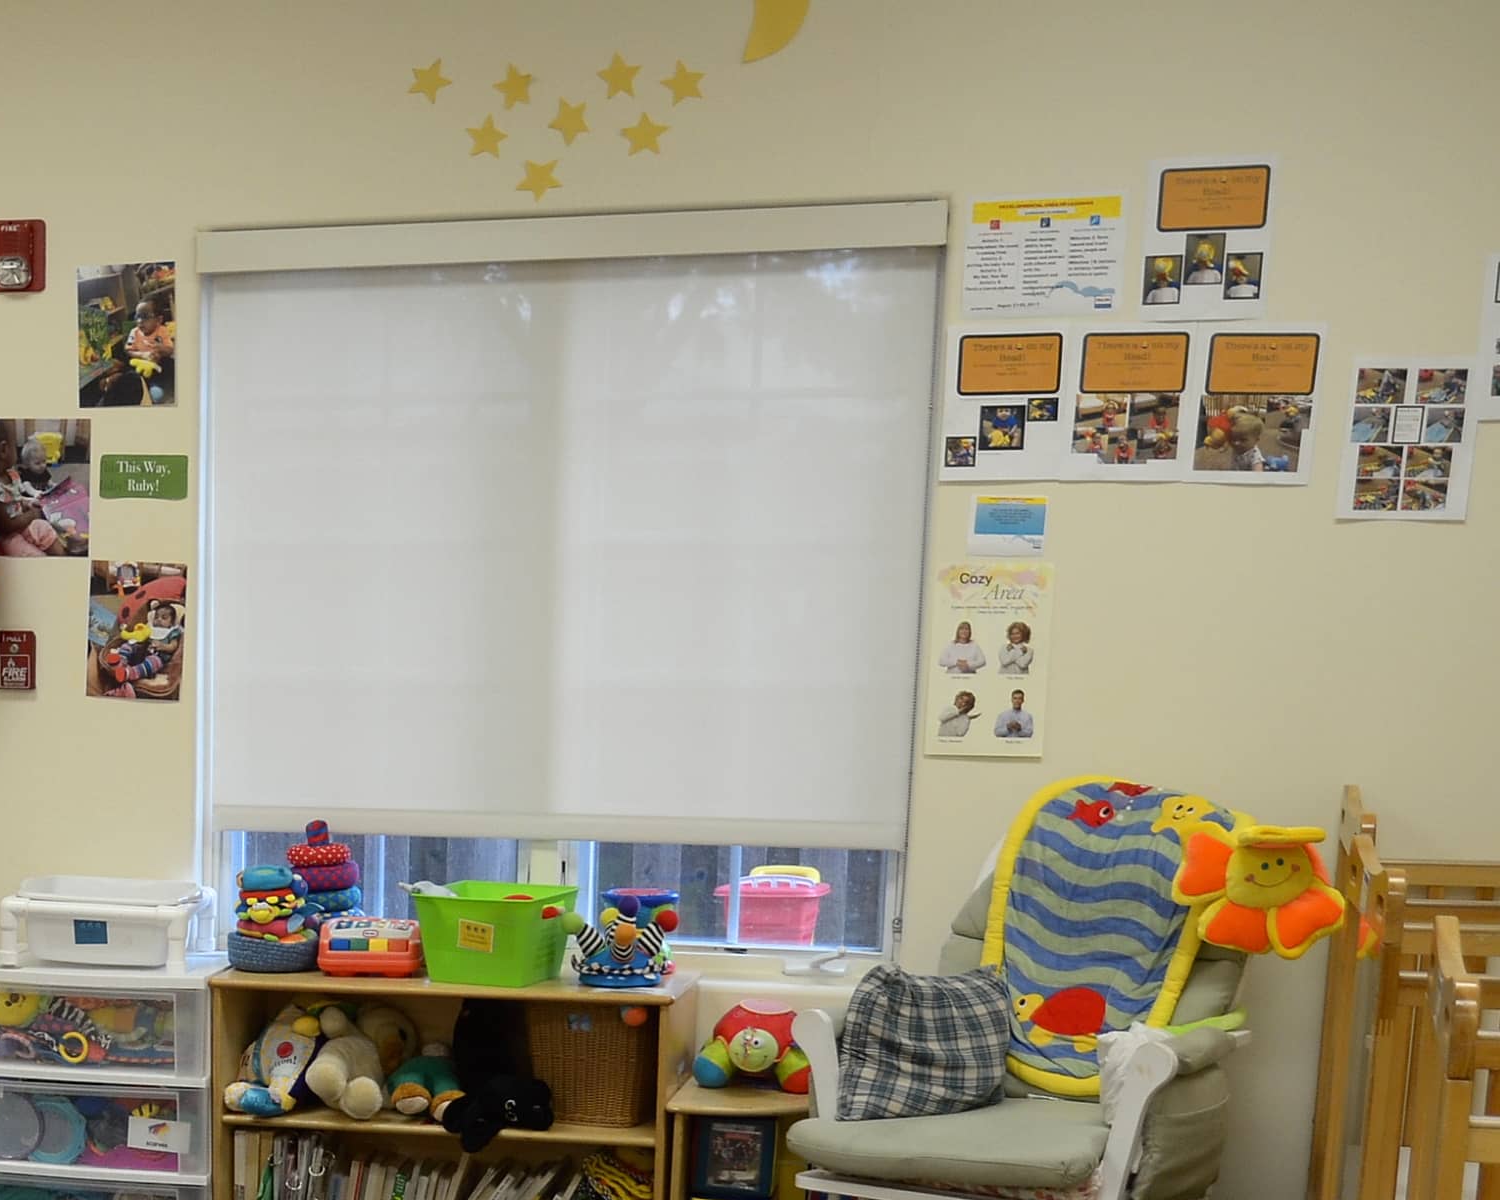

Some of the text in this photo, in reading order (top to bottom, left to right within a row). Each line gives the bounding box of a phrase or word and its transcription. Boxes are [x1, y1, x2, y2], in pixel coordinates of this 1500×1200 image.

[116, 460, 171, 477] This Way,
[127, 479, 160, 496] Ruby!
[959, 572, 993, 587] Cozy
[982, 583, 1025, 600] Area
